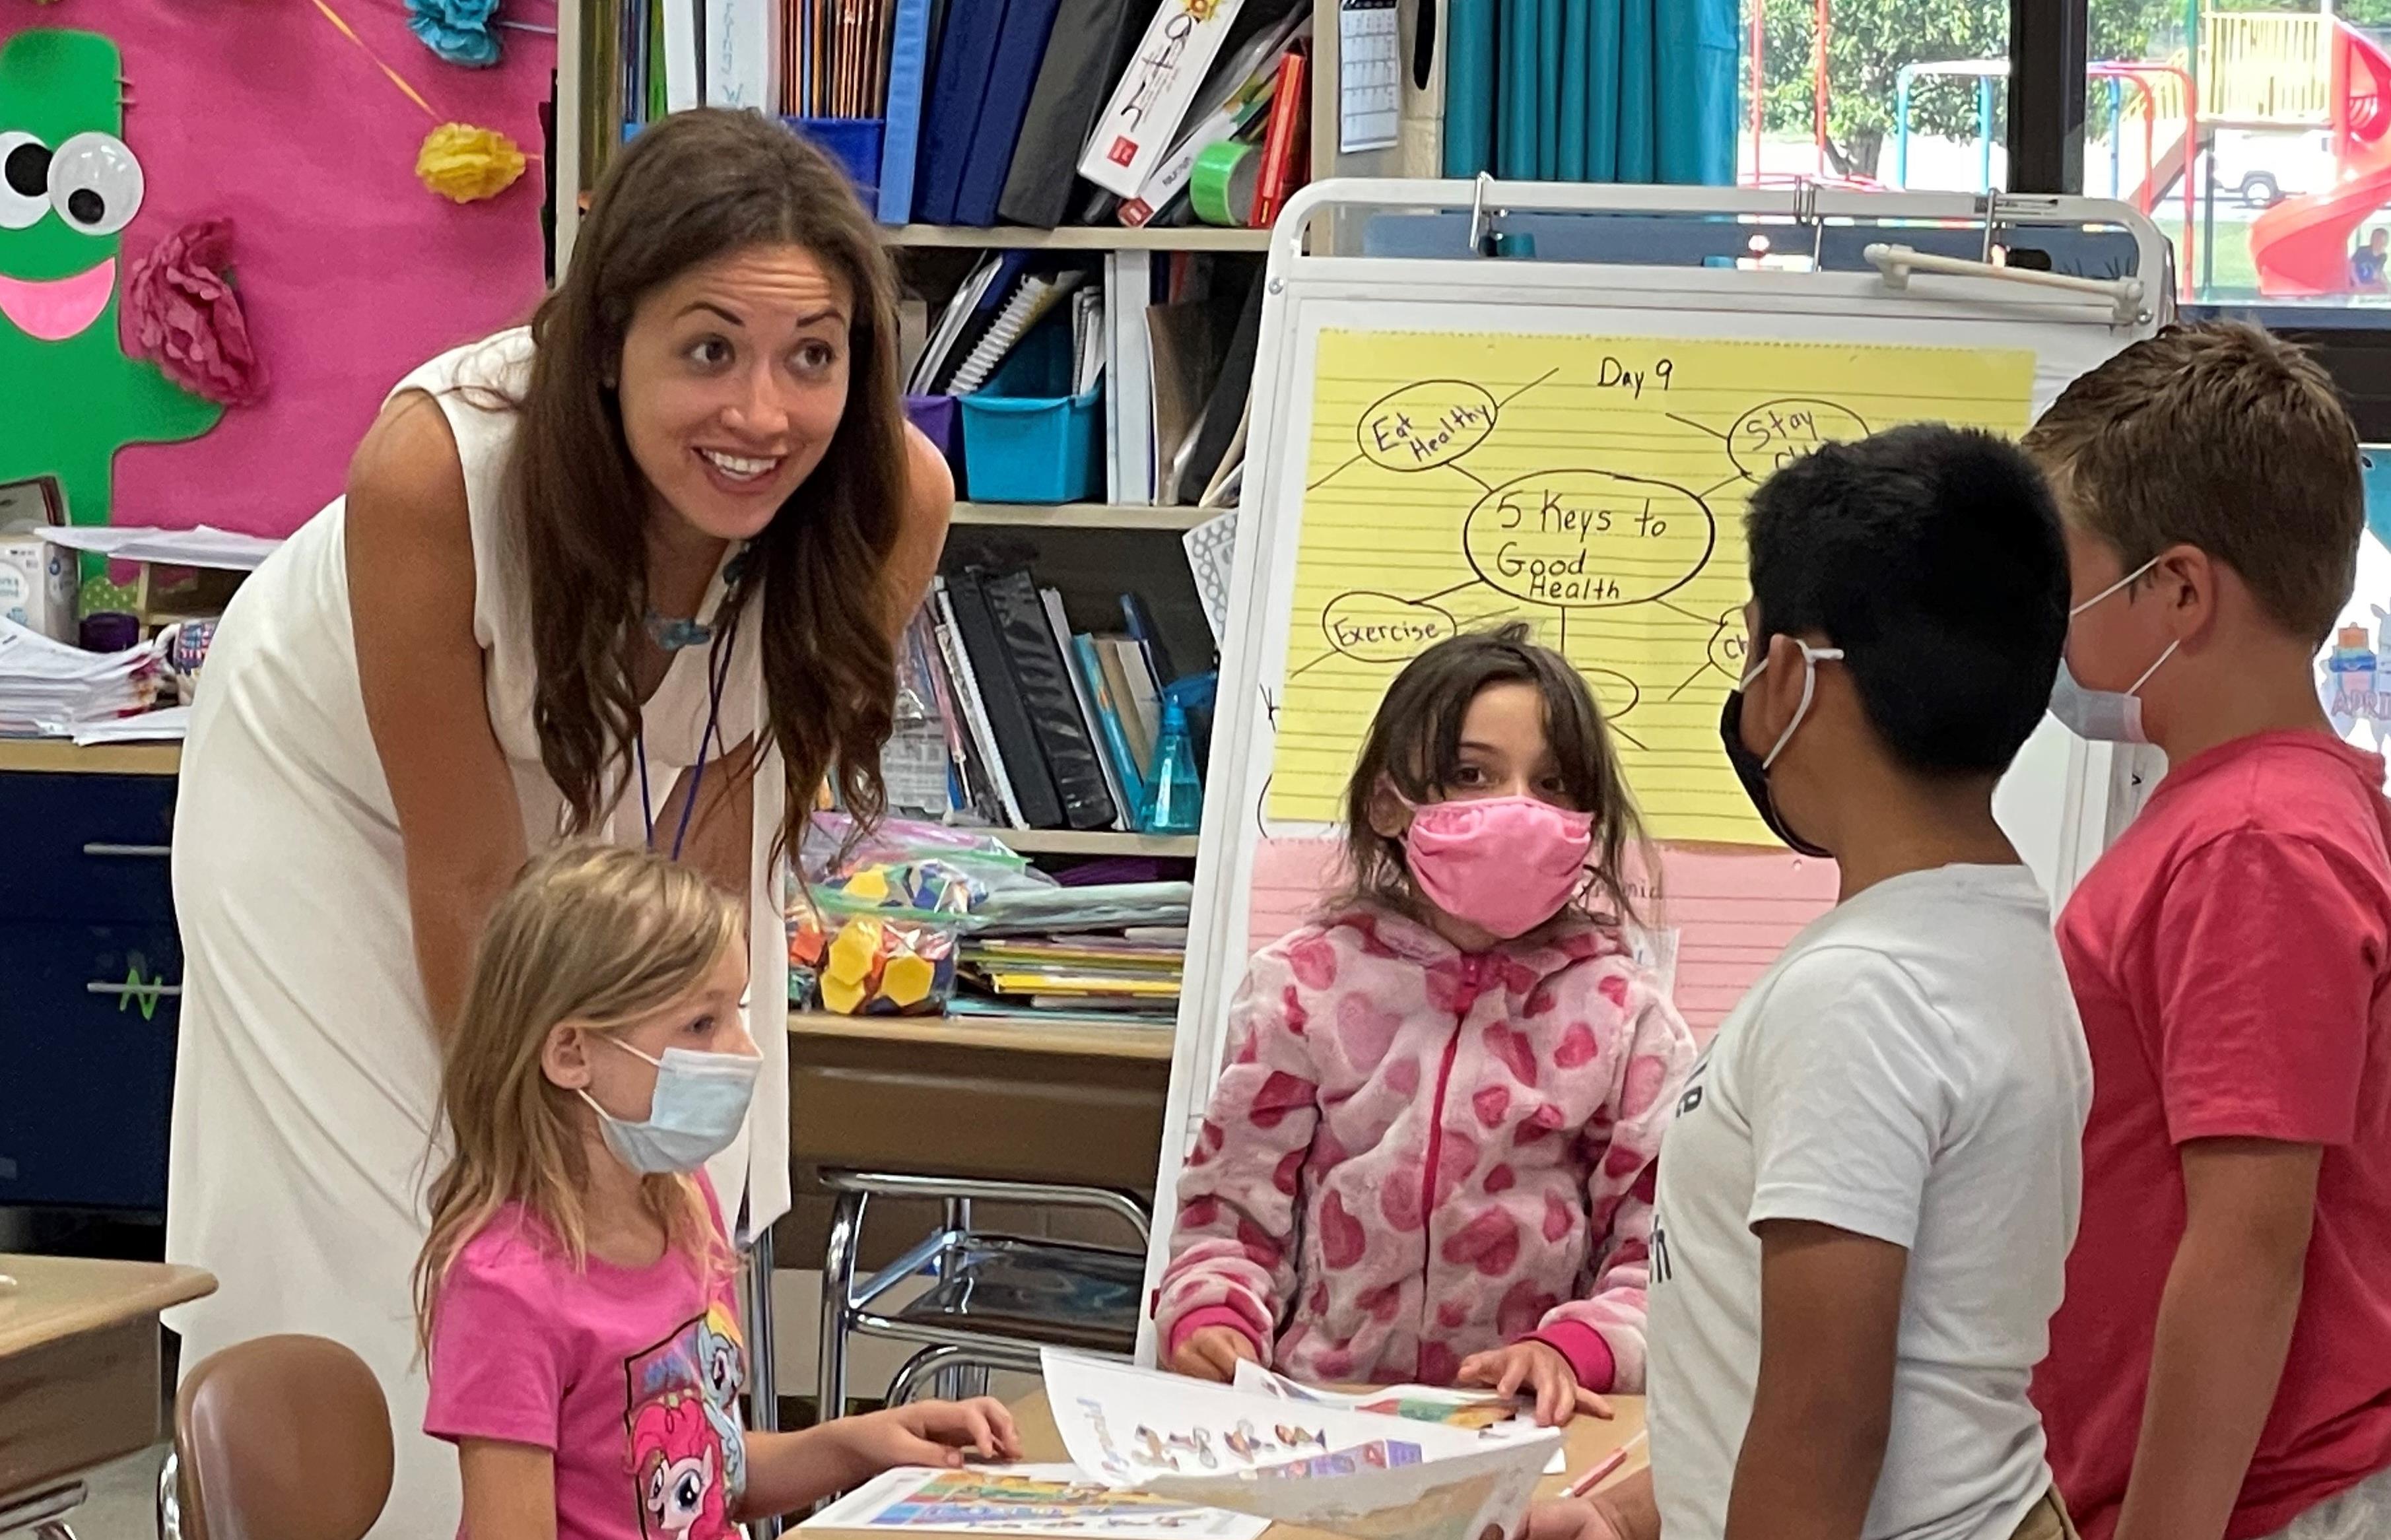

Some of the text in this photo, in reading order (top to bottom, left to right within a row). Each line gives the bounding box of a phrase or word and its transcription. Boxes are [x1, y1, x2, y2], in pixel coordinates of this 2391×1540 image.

[1597, 356, 1673, 400] Day 9
[1372, 411, 1413, 452] Eat
[1409, 404, 1493, 462] Healthy
[1746, 410, 1818, 452] Stay
[1497, 489, 1667, 543] 5 Keys to
[1497, 541, 1586, 577] Good
[1530, 574, 1620, 600] Health
[1333, 617, 1440, 647] Exercise
[2331, 689, 2391, 720] APRI
